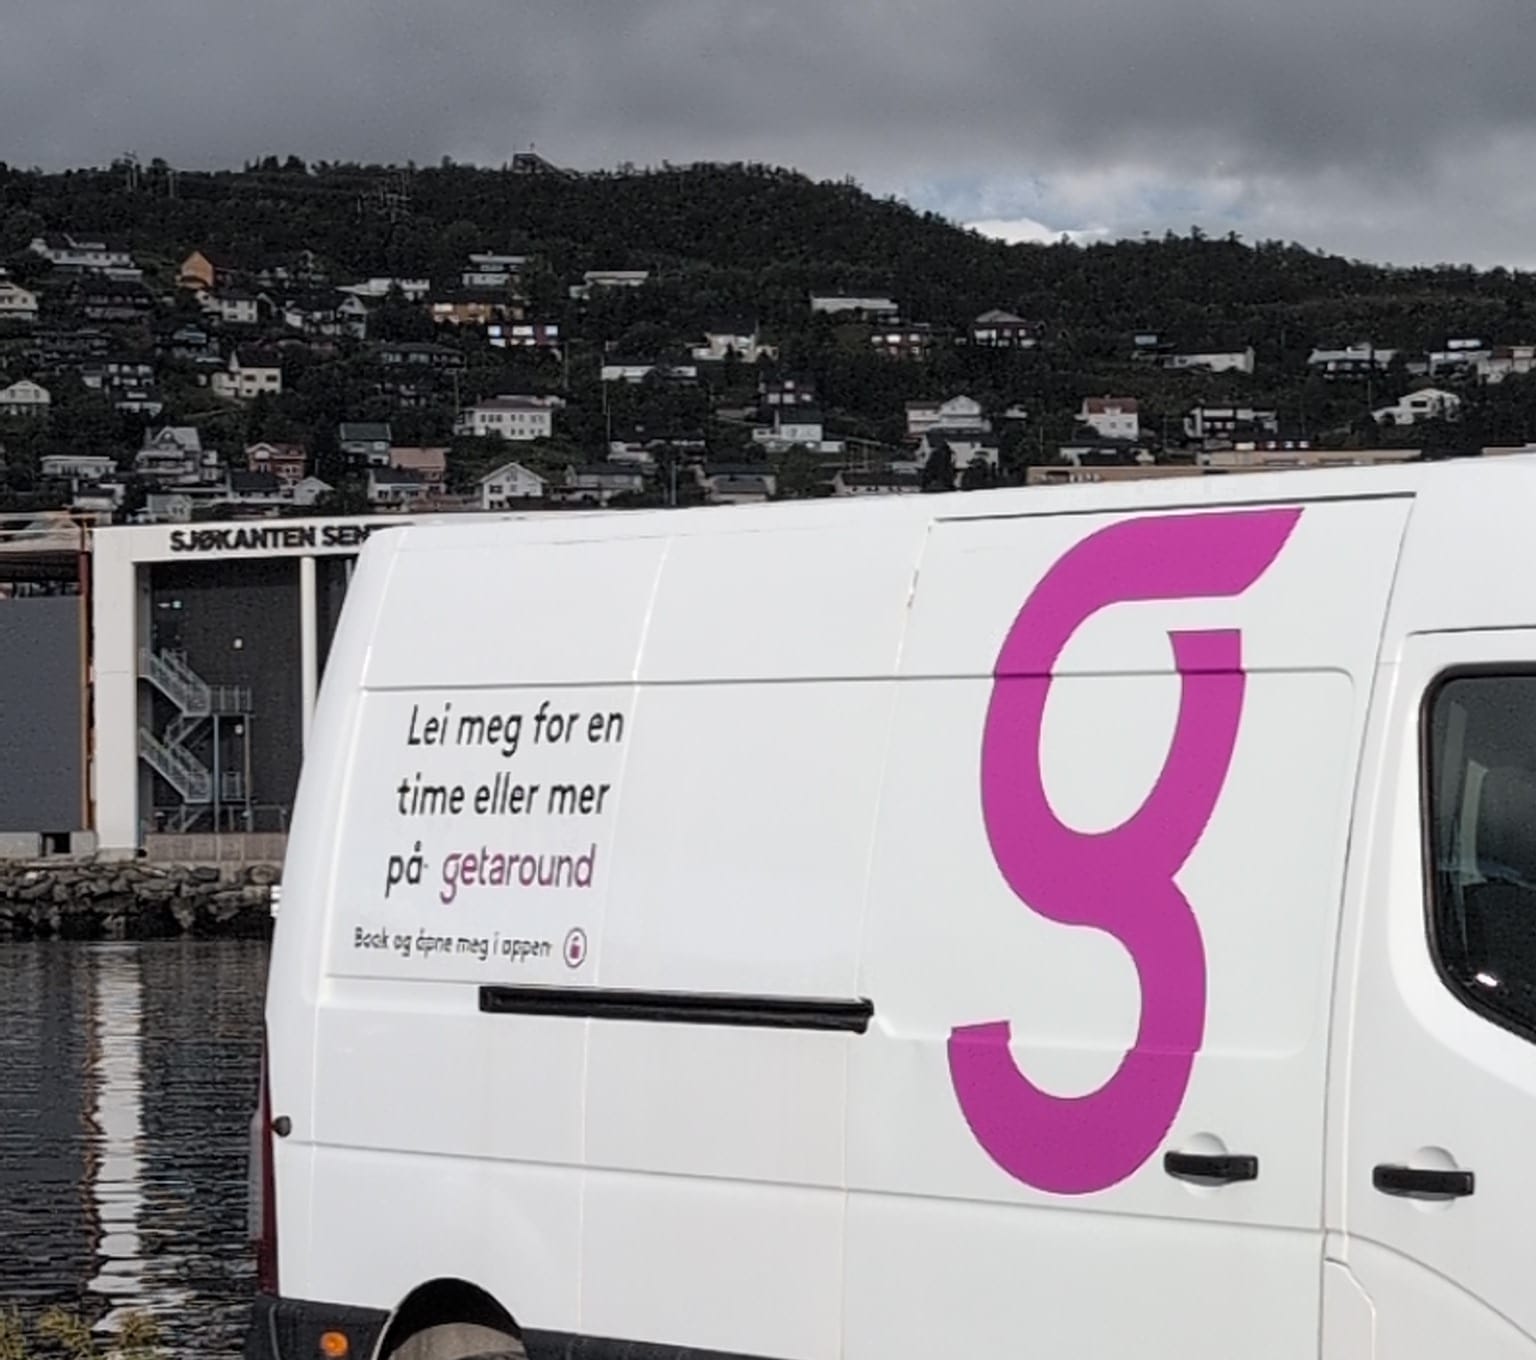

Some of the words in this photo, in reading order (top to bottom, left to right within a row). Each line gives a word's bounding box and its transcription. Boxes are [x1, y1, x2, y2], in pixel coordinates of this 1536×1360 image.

[169, 526, 317, 552] SJØKANTEN
[321, 524, 374, 547] SEN
[407, 702, 451, 745] Lei
[456, 714, 522, 757] meg
[533, 700, 580, 744] for
[588, 711, 624, 743] en
[397, 772, 465, 816] time
[474, 771, 540, 815] eller
[548, 783, 610, 815] mer
[384, 840, 424, 898] på
[439, 842, 597, 904] getaround
[354, 926, 389, 950] Book
[393, 934, 412, 957] og
[415, 927, 453, 959] åpne
[456, 936, 488, 961] meg
[492, 930, 499, 955] i
[502, 938, 552, 963] appen
